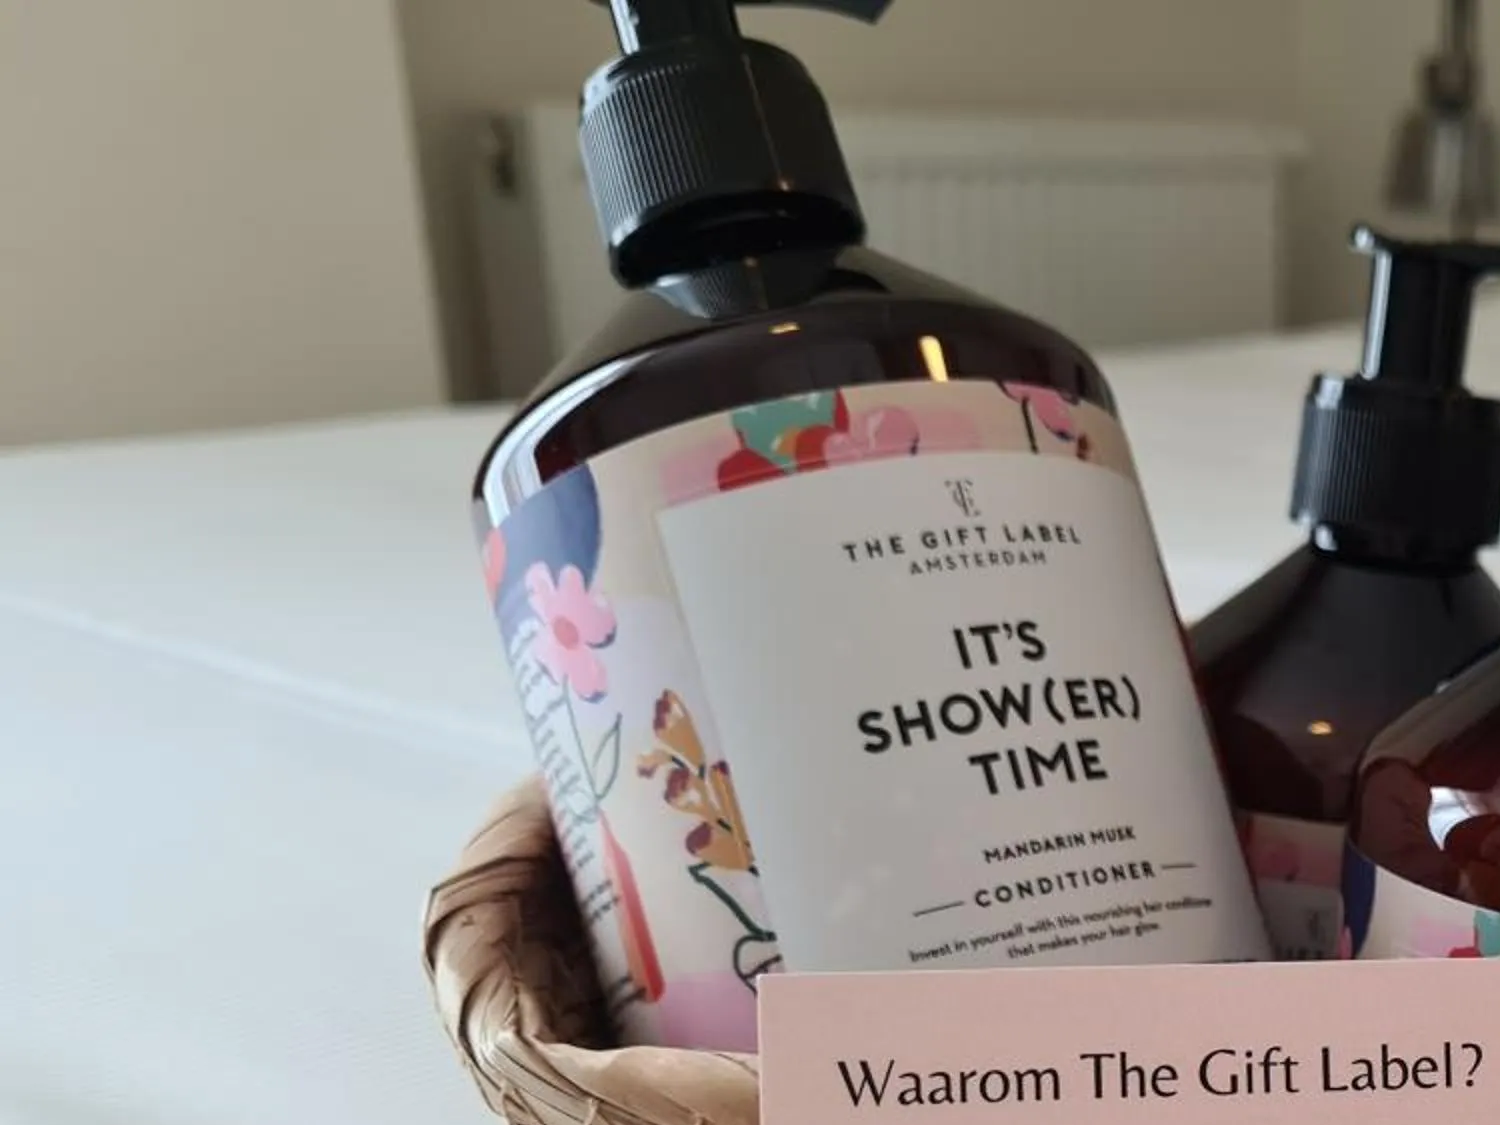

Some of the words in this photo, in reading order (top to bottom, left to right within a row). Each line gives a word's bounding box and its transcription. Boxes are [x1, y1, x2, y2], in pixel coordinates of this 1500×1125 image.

[842, 536, 905, 562] THE
[920, 526, 987, 549] GIFT
[1001, 524, 1081, 545] LABEL
[909, 550, 1047, 575] AMSTERDAM
[952, 620, 1047, 670] IT'S
[856, 675, 1140, 754] SHOW(ER)
[967, 739, 1109, 795] TIME
[983, 835, 1085, 863] MANDARIN
[1089, 826, 1136, 845] MUSK
[974, 861, 1155, 908] CONDITIONER
[836, 1058, 1061, 1108] Waarom
[1079, 1050, 1179, 1100] The
[1197, 1045, 1301, 1097] Gift
[1320, 1041, 1484, 1093] Label?
